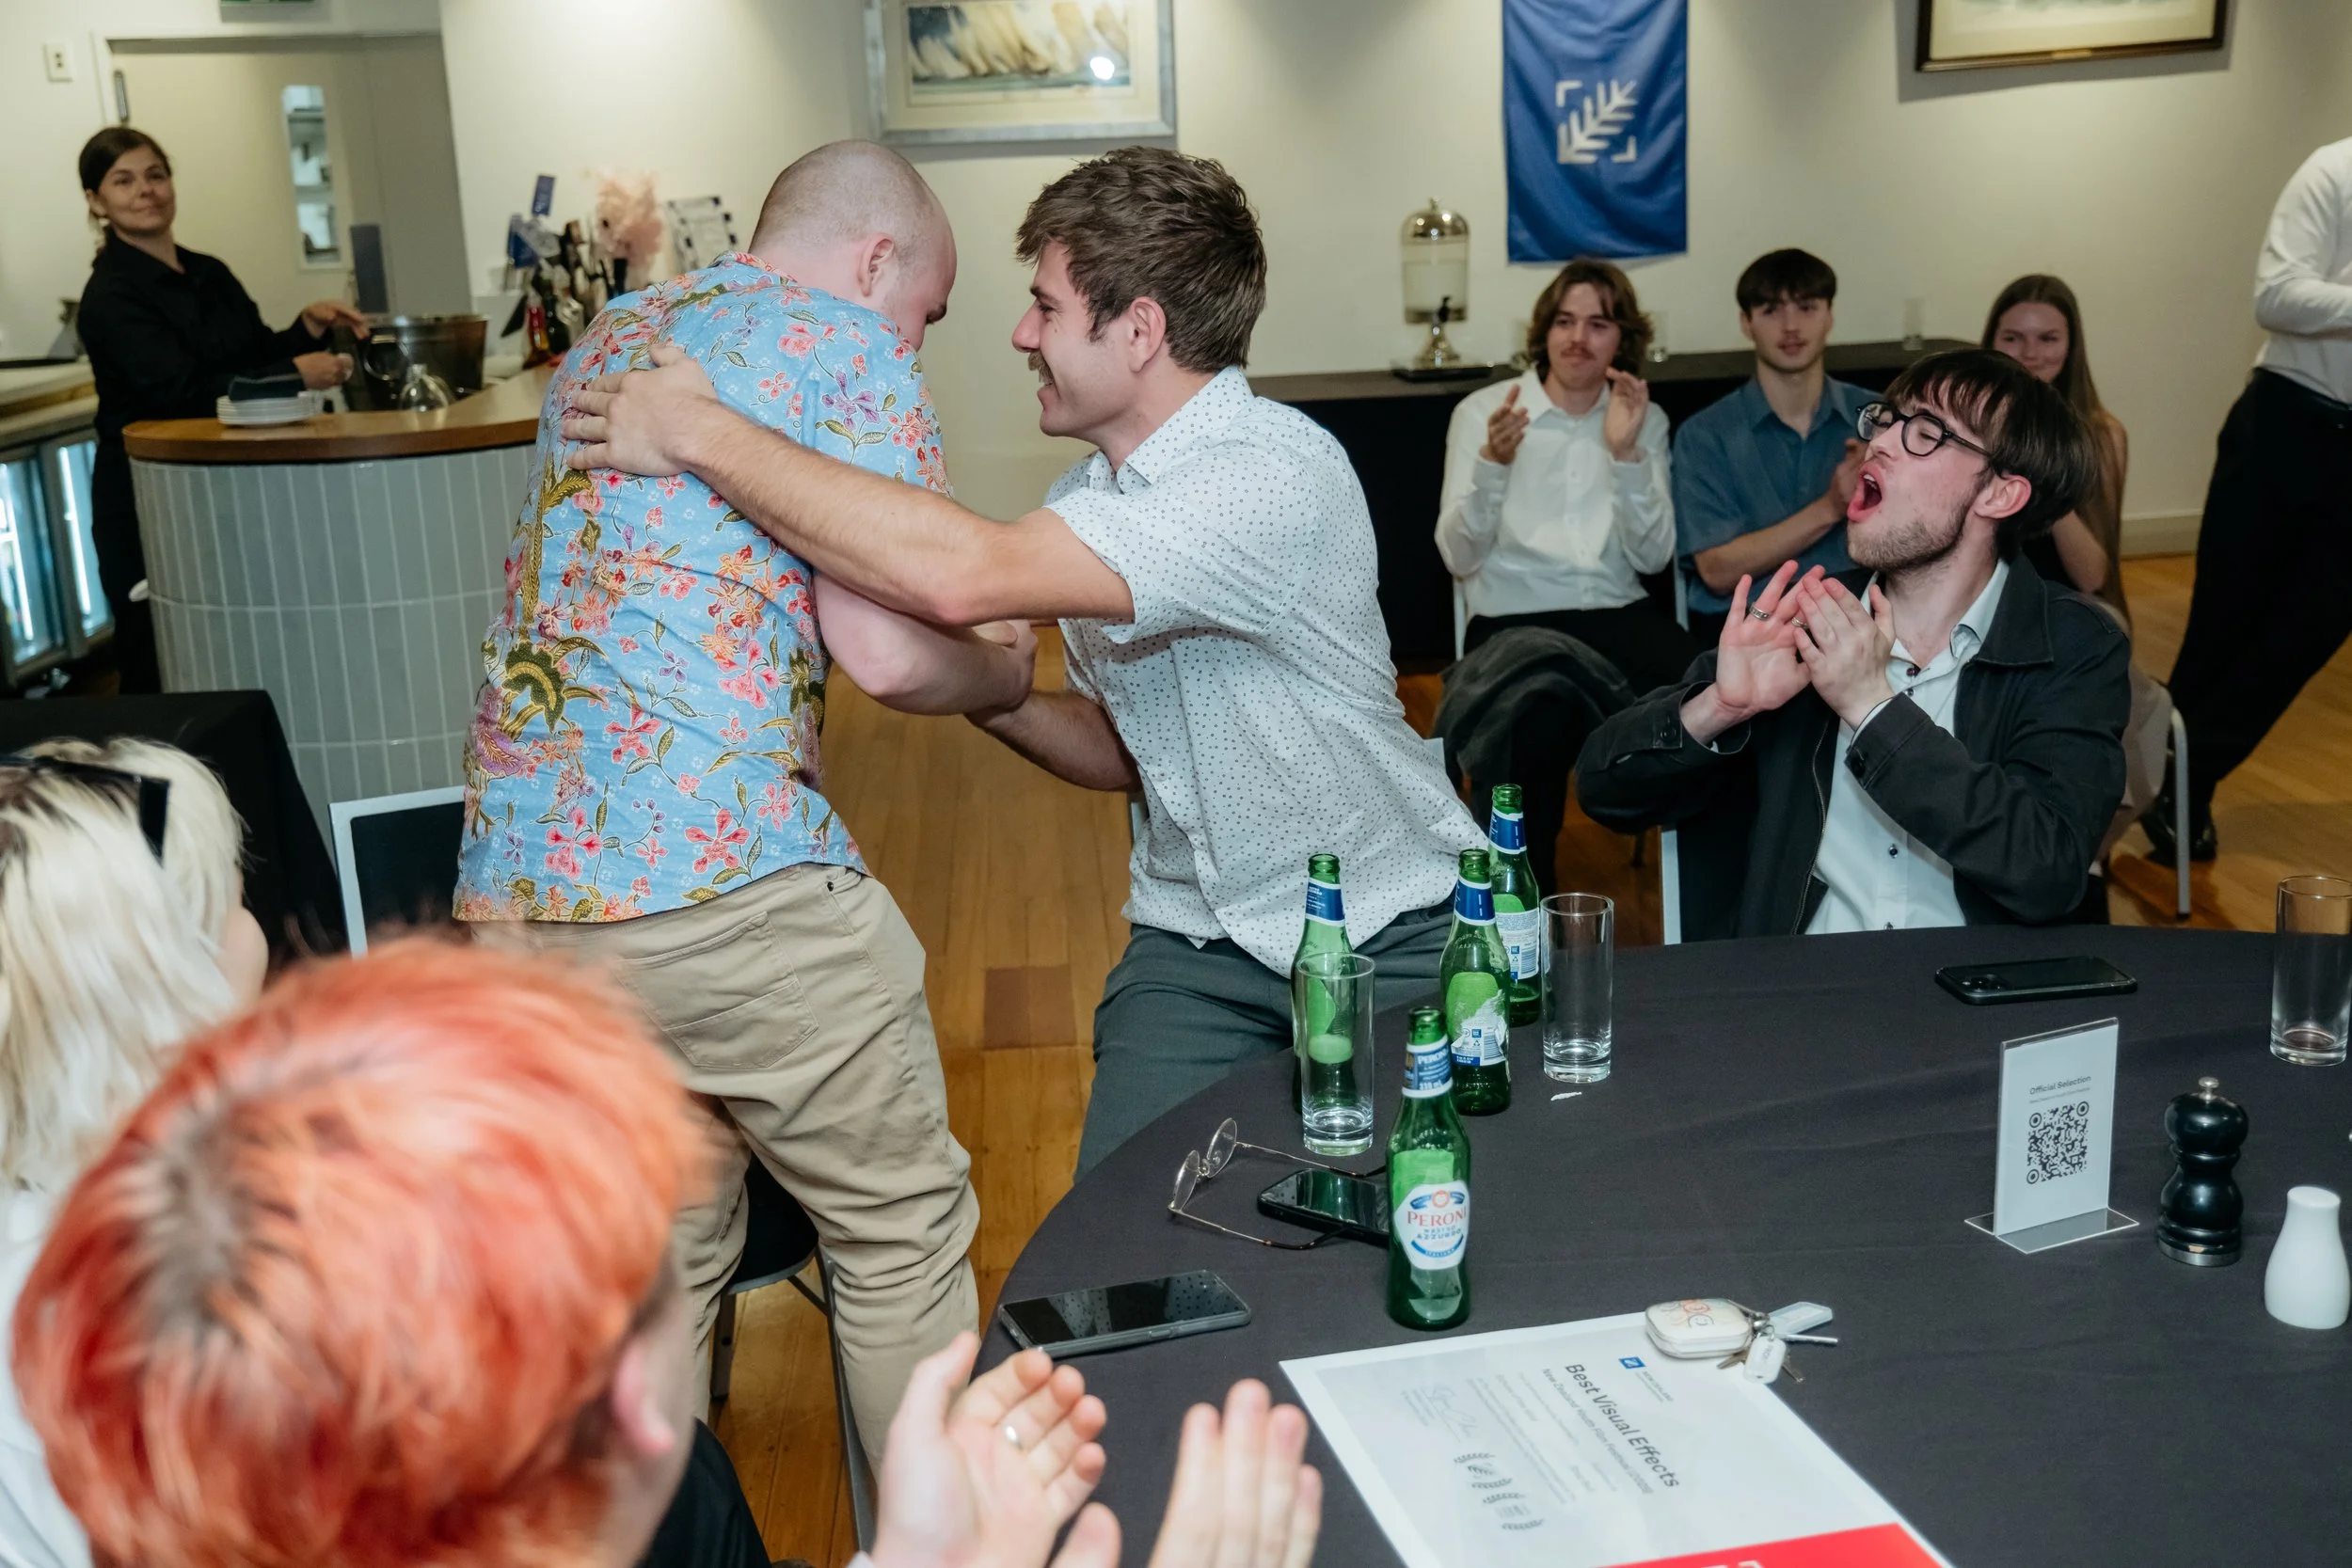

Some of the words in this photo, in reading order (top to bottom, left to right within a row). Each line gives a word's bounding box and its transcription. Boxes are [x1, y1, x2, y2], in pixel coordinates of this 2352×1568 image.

[2029, 1083, 2056, 1095] Official
[2057, 1076, 2091, 1088] Selection
[1416, 1228, 1461, 1241] AZZURRO
[1542, 1369, 1557, 1383] New
[1553, 1383, 1580, 1409] Zealand
[1565, 1364, 1600, 1394] Best
[1592, 1395, 1641, 1435] Visual
[1628, 1437, 1679, 1488] Effects
